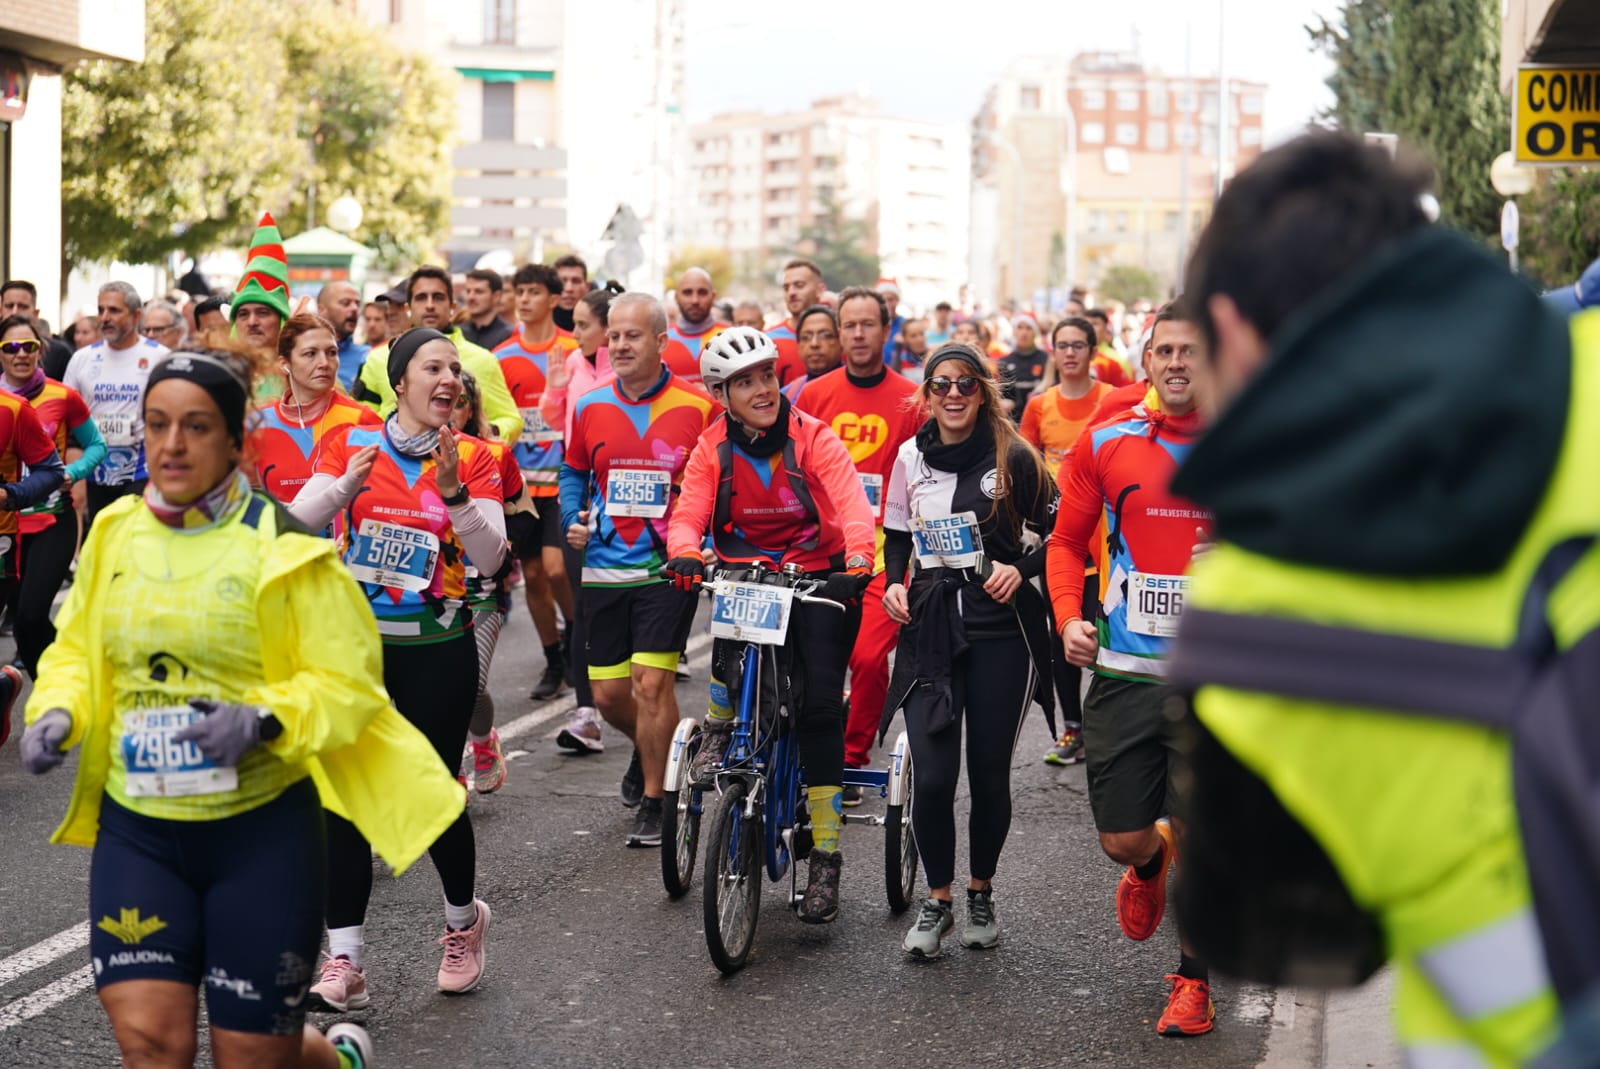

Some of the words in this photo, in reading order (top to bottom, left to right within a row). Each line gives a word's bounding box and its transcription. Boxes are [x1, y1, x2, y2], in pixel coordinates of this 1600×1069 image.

[840, 424, 878, 444] CH
[624, 472, 665, 482] SETEL
[615, 482, 655, 502] 3356
[887, 502, 904, 512] ental
[1146, 508, 1158, 516] SAN
[1159, 508, 1190, 518] SILVESTRE
[925, 516, 969, 529] SETEL
[381, 527, 432, 546] SETEL
[921, 529, 963, 551] 3066
[367, 539, 415, 569] 5192
[1146, 578, 1190, 589] SETE
[735, 587, 783, 601] SETEL
[1139, 590, 1183, 616] 1096
[722, 597, 771, 624] 3067
[146, 713, 201, 728] SETE
[131, 732, 204, 768] 2960
[108, 950, 175, 967] AQUONA
